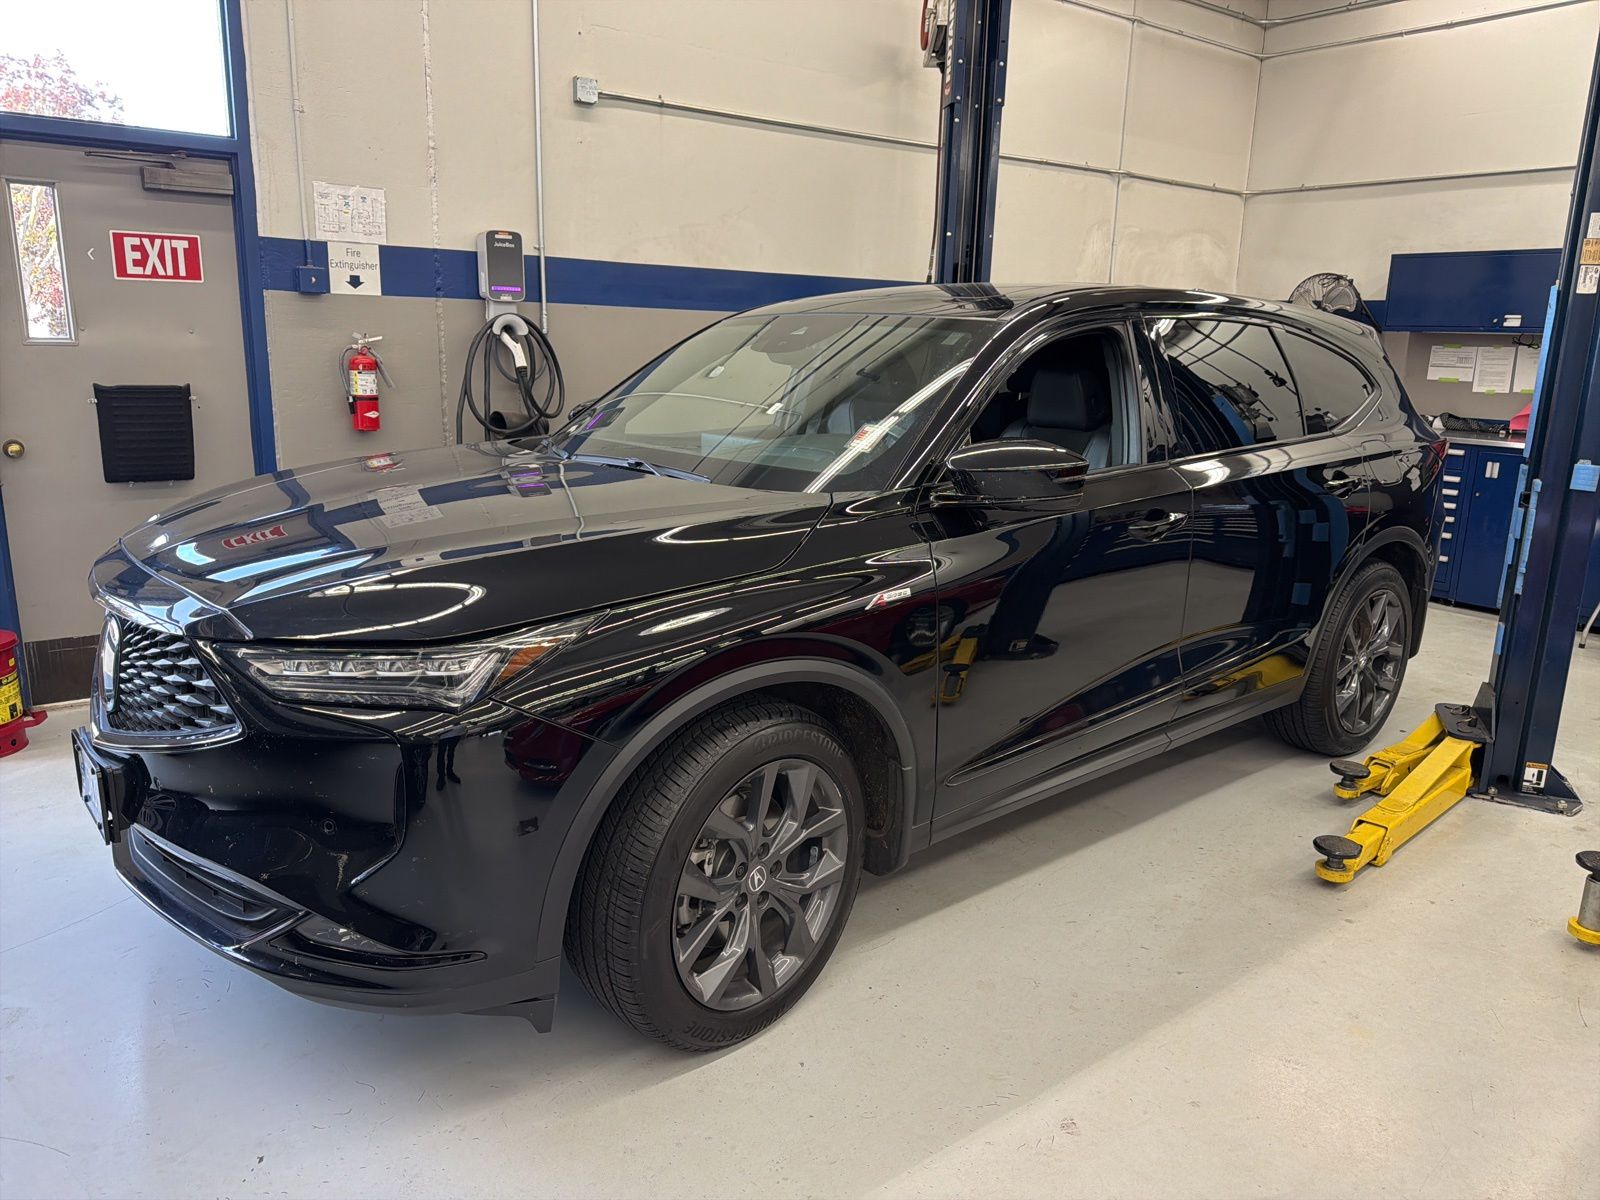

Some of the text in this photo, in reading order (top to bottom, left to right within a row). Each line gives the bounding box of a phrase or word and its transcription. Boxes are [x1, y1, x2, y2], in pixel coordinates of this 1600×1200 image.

[123, 236, 189, 277] EXIT
[345, 247, 361, 258] Fire
[329, 258, 378, 271] Extinguisher
